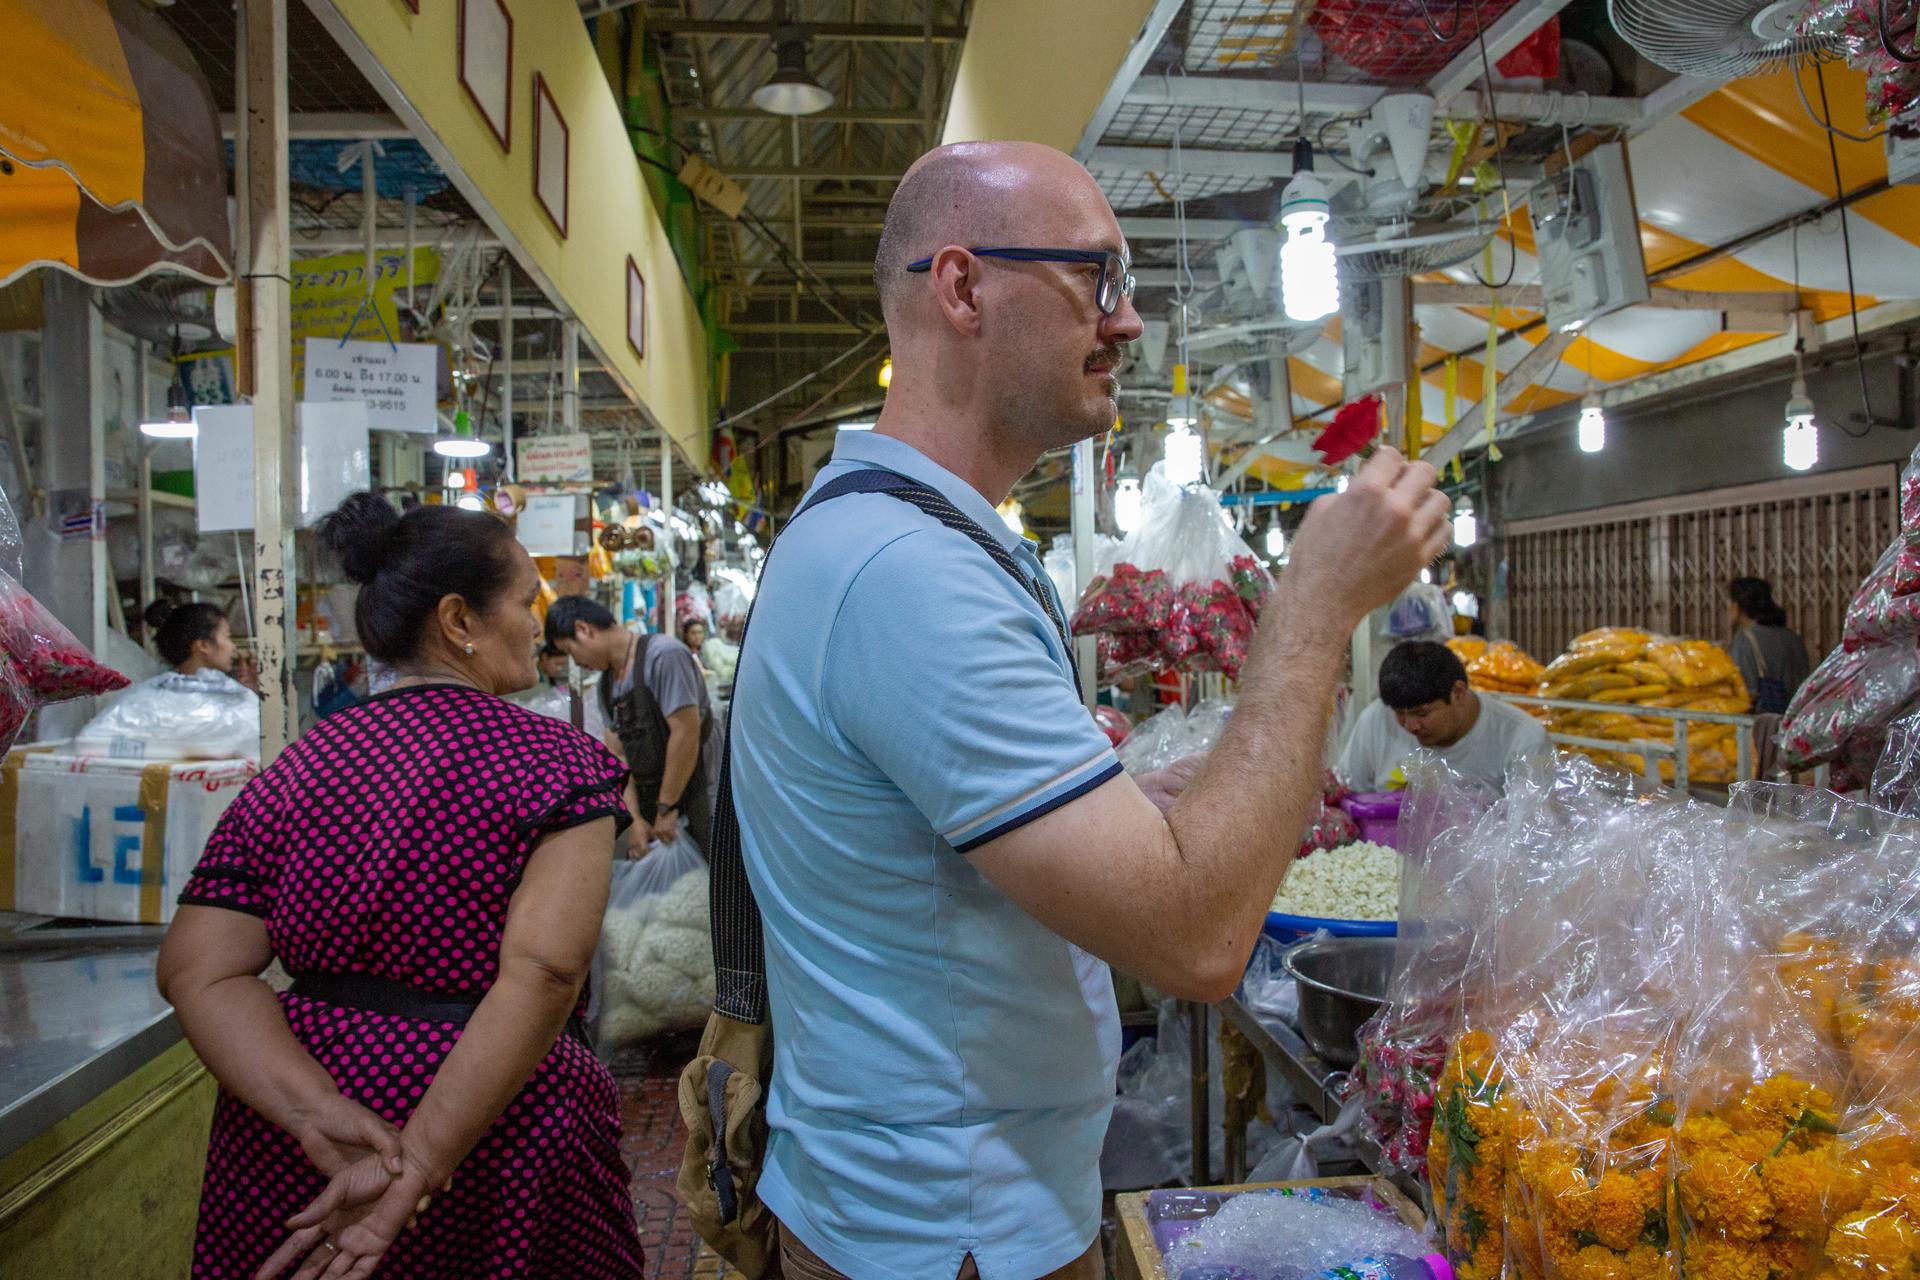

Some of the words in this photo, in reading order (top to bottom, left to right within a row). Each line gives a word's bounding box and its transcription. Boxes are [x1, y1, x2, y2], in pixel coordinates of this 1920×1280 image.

[314, 367, 341, 380] 6.00
[360, 367, 374, 381] ถึง
[379, 372, 408, 384] 17.00
